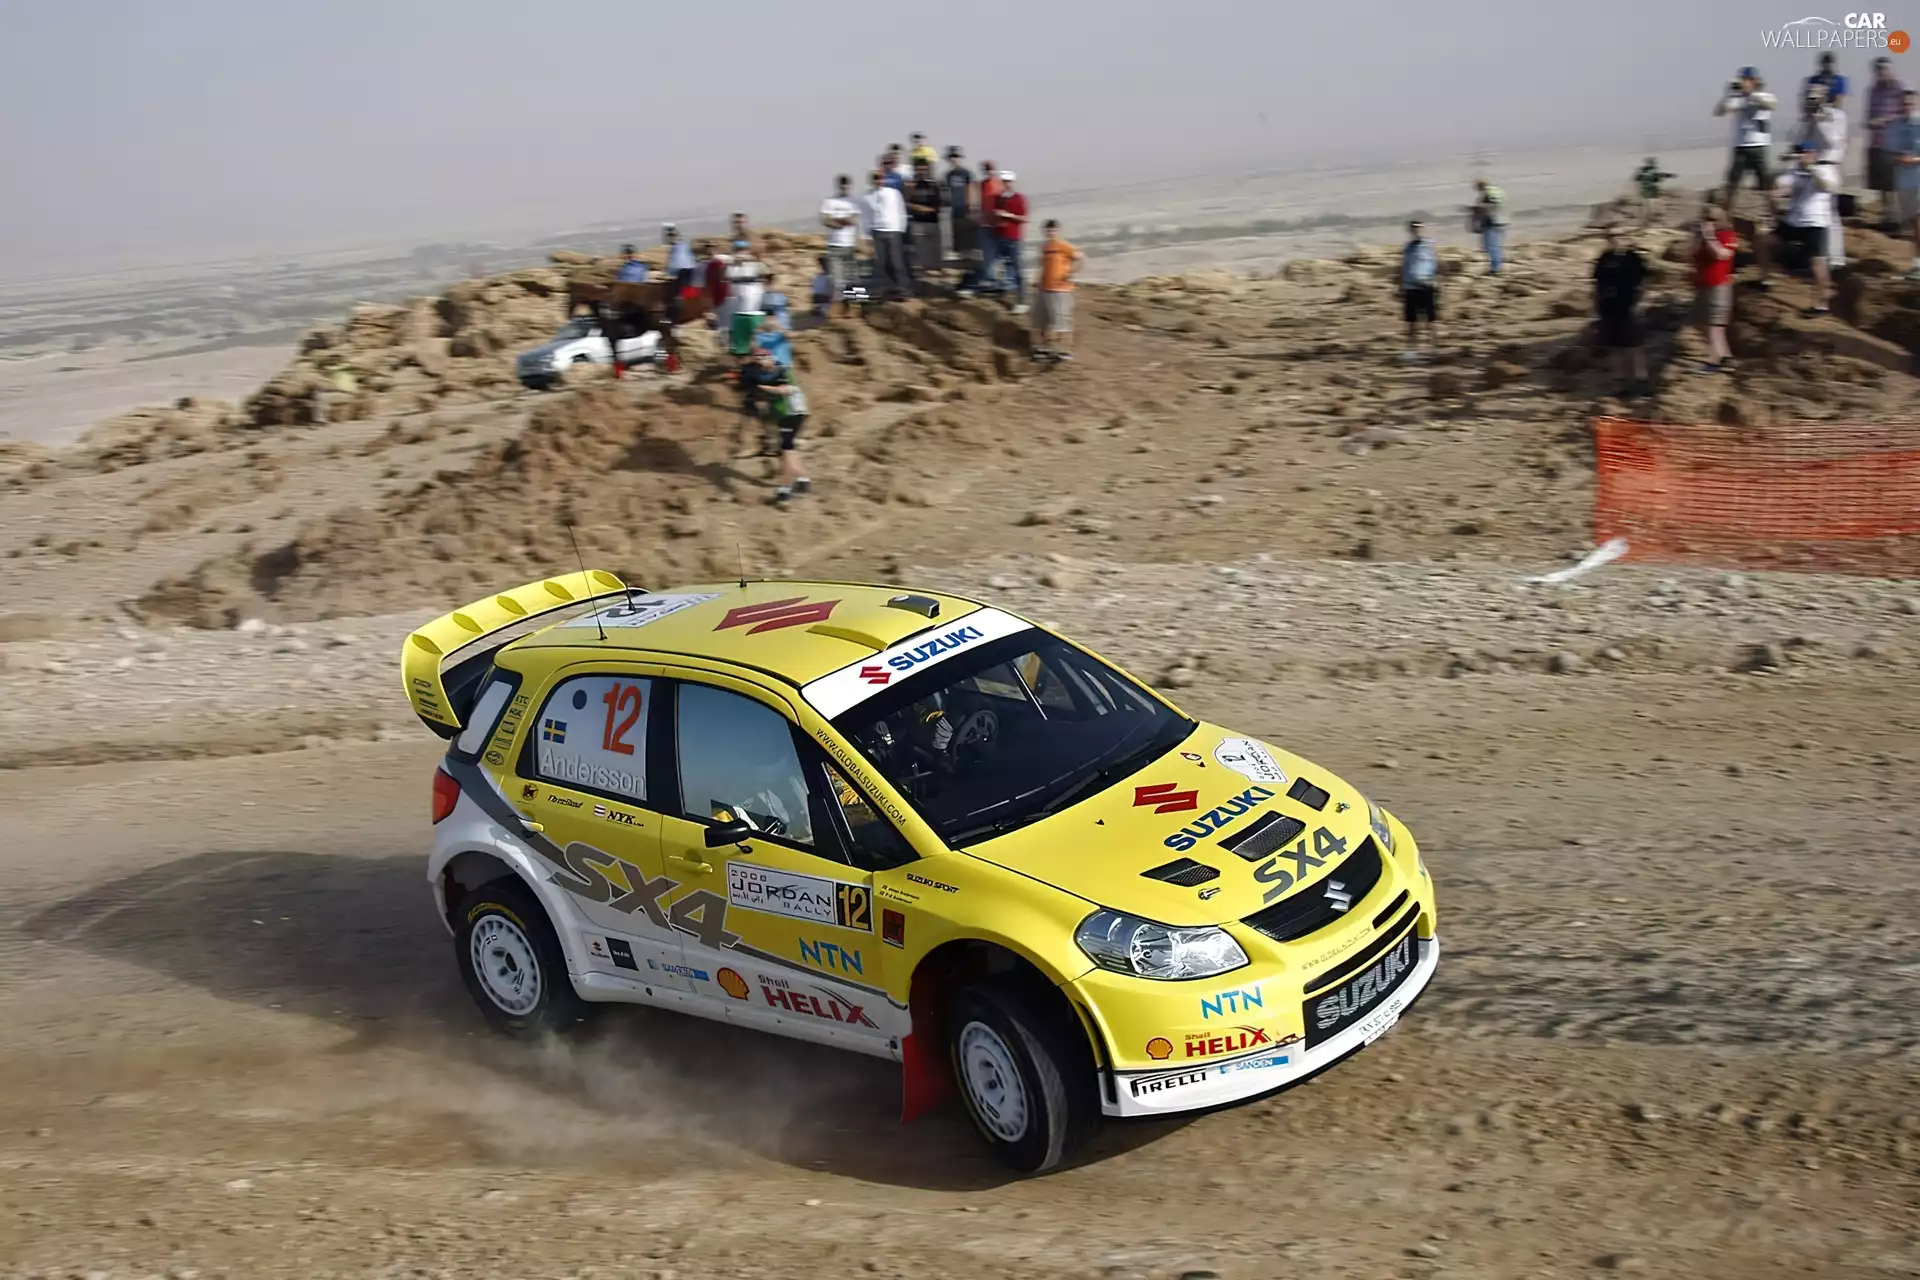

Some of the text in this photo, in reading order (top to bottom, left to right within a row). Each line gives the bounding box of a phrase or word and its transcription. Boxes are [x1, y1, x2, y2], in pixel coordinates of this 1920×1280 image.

[887, 626, 984, 671] SUZUKI
[602, 682, 642, 756] 12
[540, 748, 647, 799] Andersson
[607, 810, 636, 826] NYK
[1164, 786, 1276, 851] SUZUKI
[1253, 826, 1347, 904] SX4
[546, 841, 743, 951] SX4
[732, 878, 832, 908] JORDAN
[783, 901, 832, 917] RALLY
[838, 885, 870, 930] 12
[799, 937, 863, 975] NTN
[758, 974, 790, 990] Shell
[1201, 986, 1264, 1019] NTN
[1317, 935, 1410, 1030] SUZUKI
[760, 985, 877, 1029] HELIX
[1185, 1028, 1269, 1058] HELIX
[1130, 1068, 1207, 1098] PIRELLI
